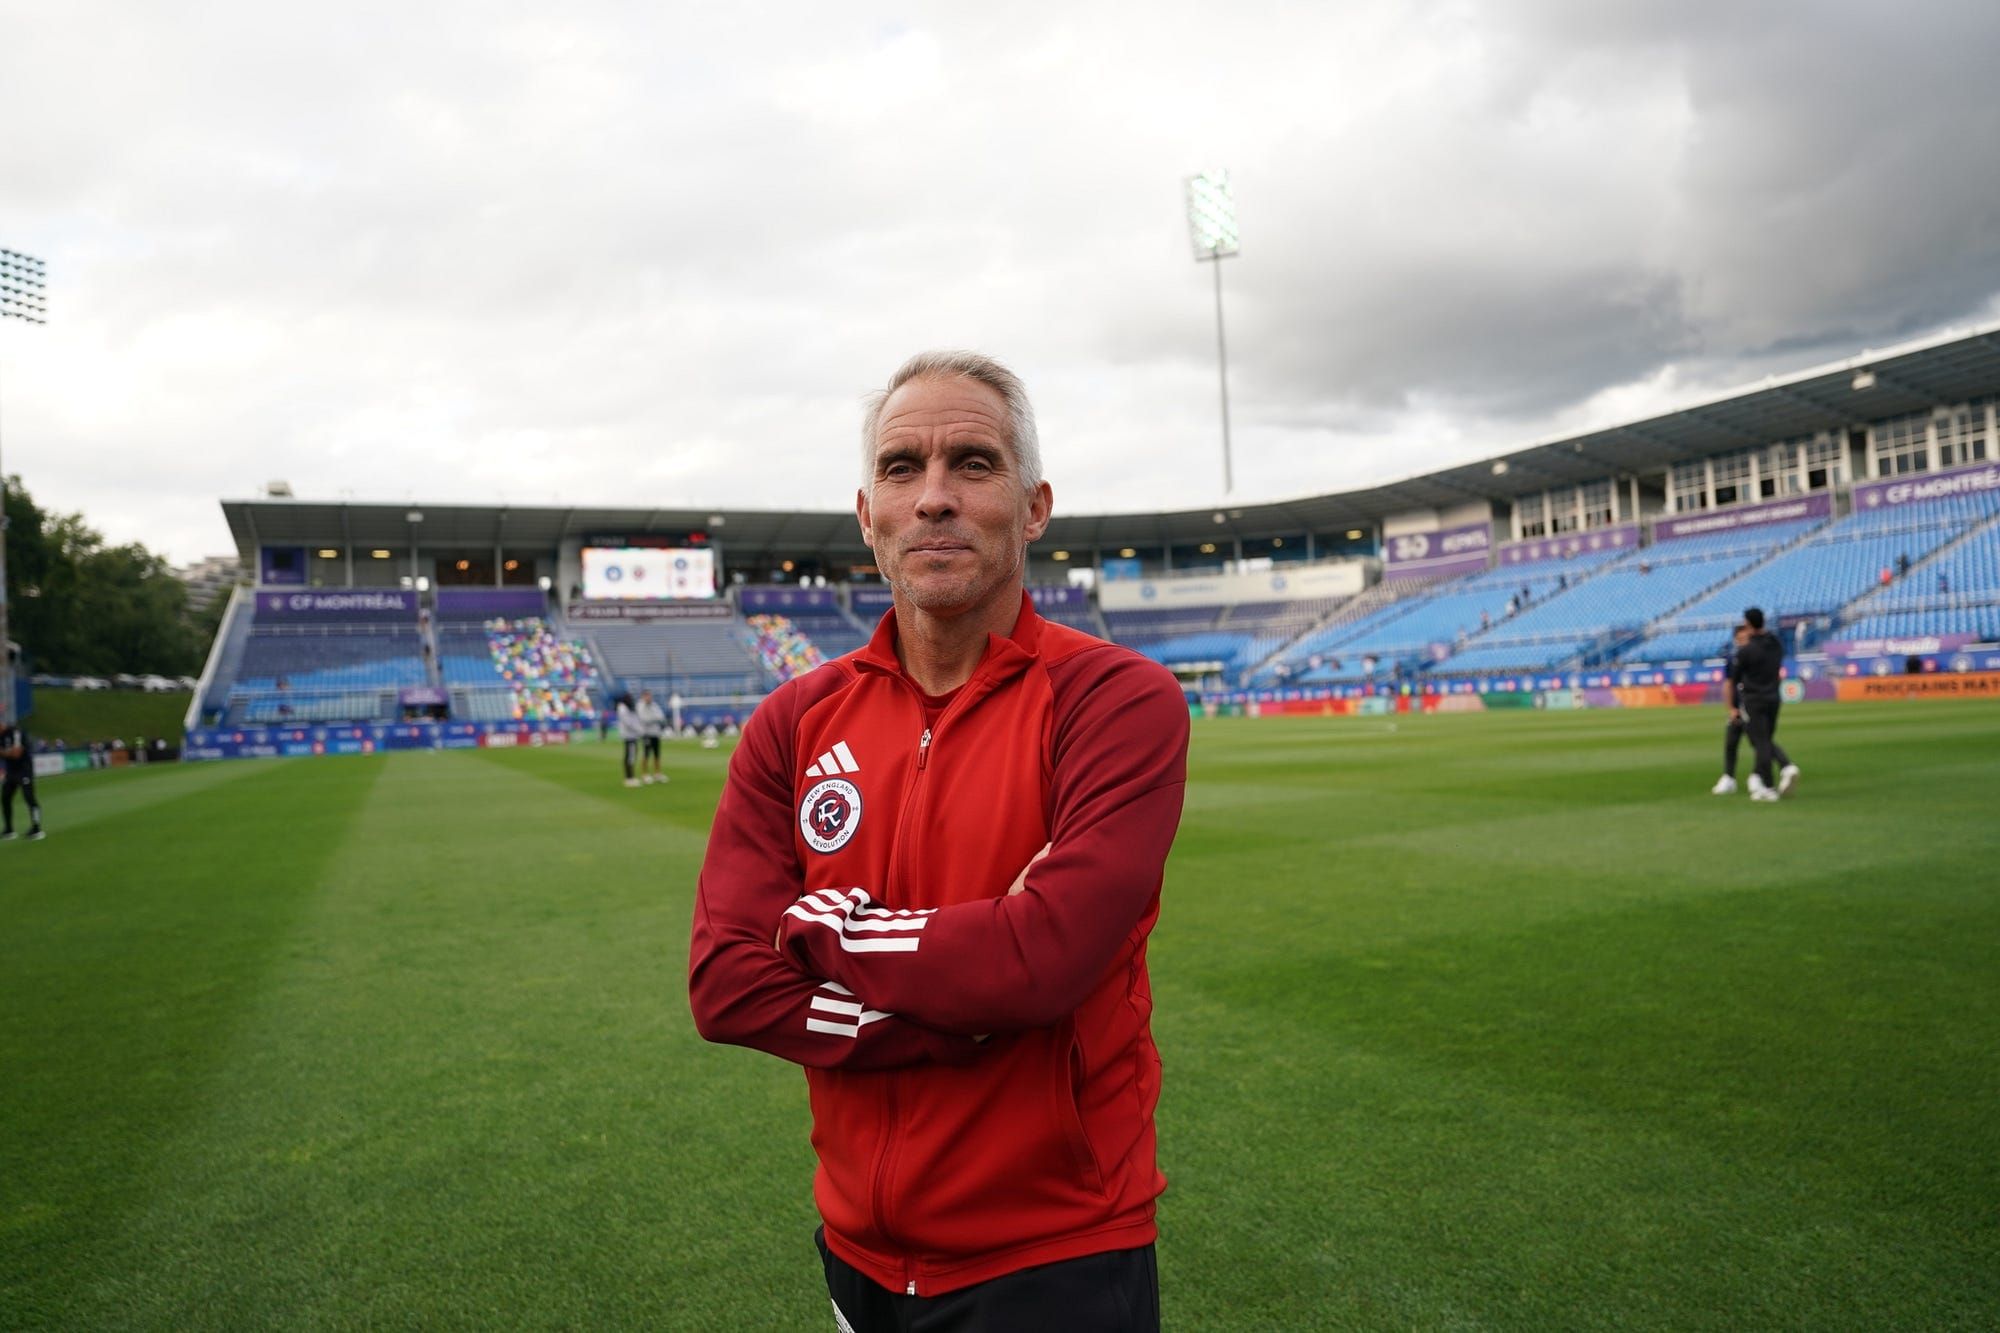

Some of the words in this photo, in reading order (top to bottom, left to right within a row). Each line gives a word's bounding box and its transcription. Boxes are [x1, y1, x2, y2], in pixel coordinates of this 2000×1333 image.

[1886, 483, 1913, 504] CF
[289, 594, 313, 610] CF
[314, 591, 406, 610] MONTRÉAL
[1865, 679, 1958, 694] PROCHAINS
[807, 788, 820, 804] NEW
[821, 782, 853, 795] ENGLAND
[813, 829, 849, 848] REVOLUTION
